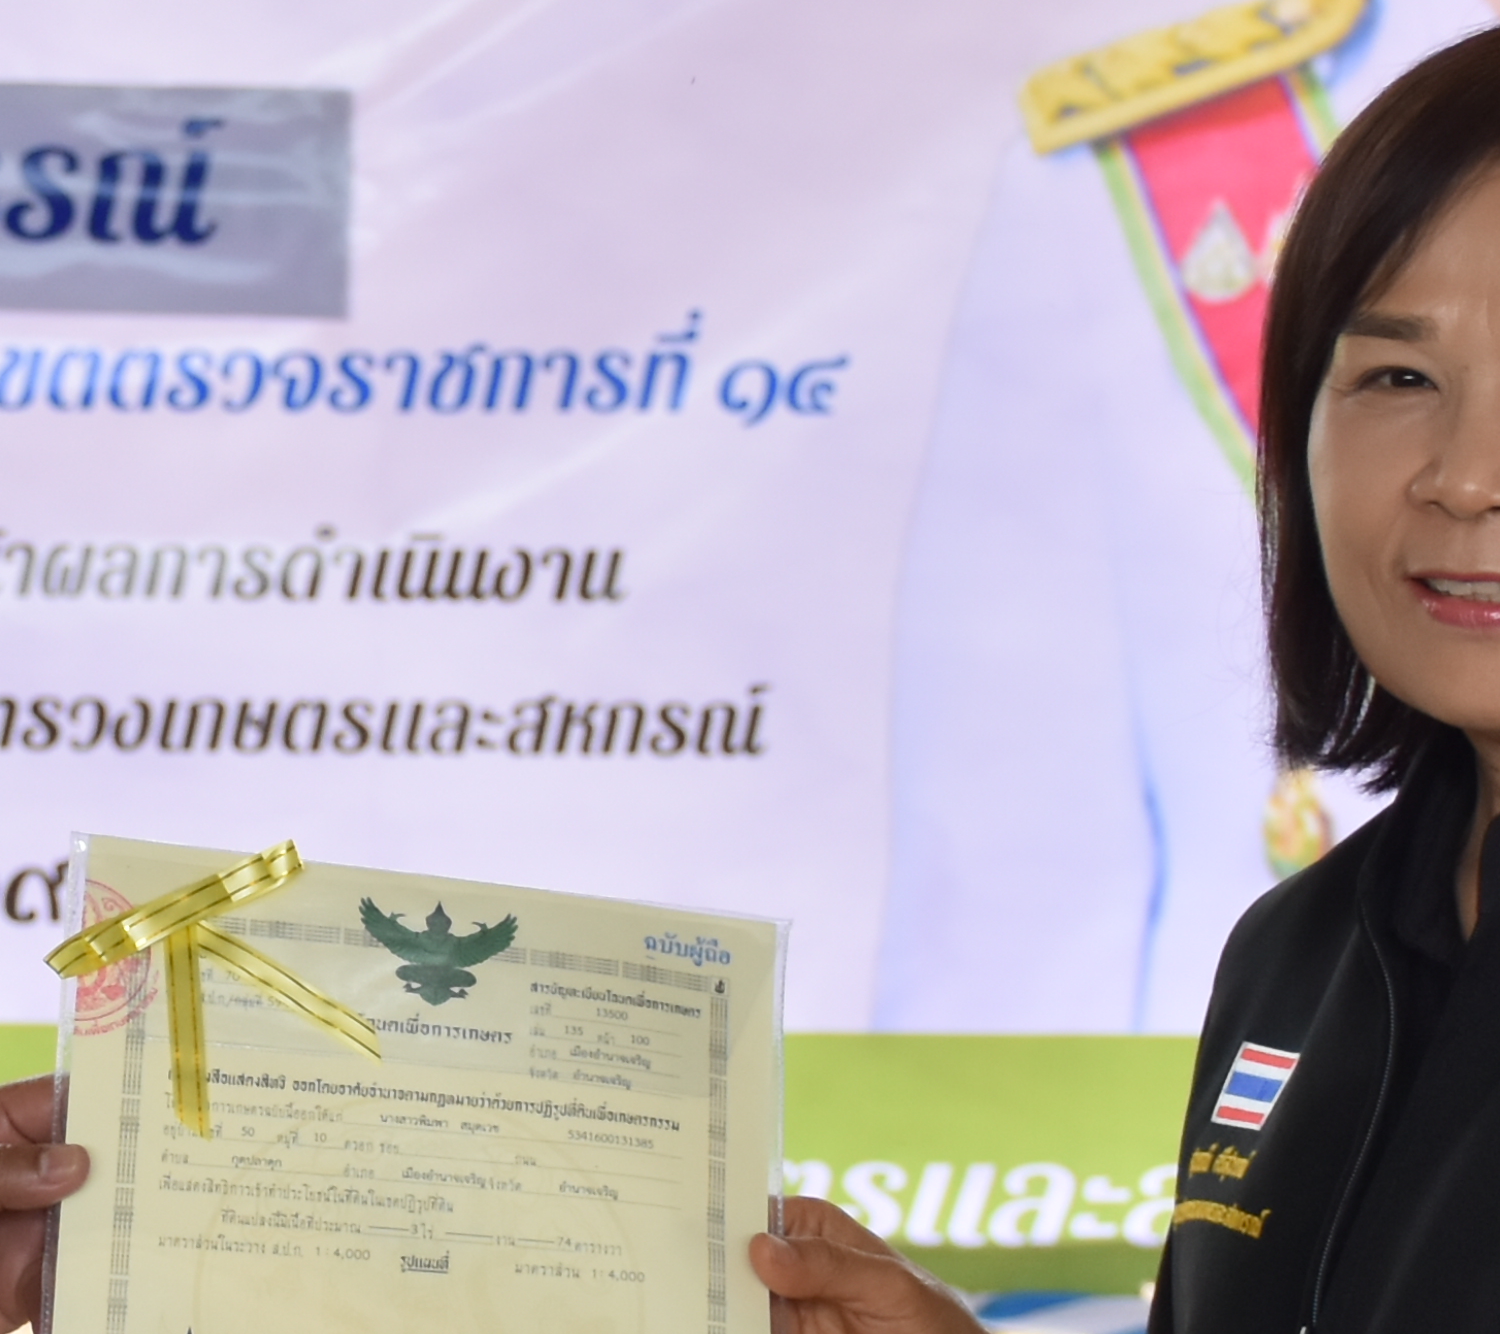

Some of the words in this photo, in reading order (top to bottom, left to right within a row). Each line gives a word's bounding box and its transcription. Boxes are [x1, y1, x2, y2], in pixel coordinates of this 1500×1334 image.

[717, 353, 850, 427] ๑๔
[643, 932, 731, 966] ฉบับผู้ถือ
[358, 1011, 514, 1044] นดเพื่อการเกษตร
[596, 1007, 629, 1021] 13500
[564, 1025, 584, 1036] 135
[630, 1034, 651, 1046] 100
[241, 1126, 255, 1138] 50
[314, 1132, 328, 1144] 10
